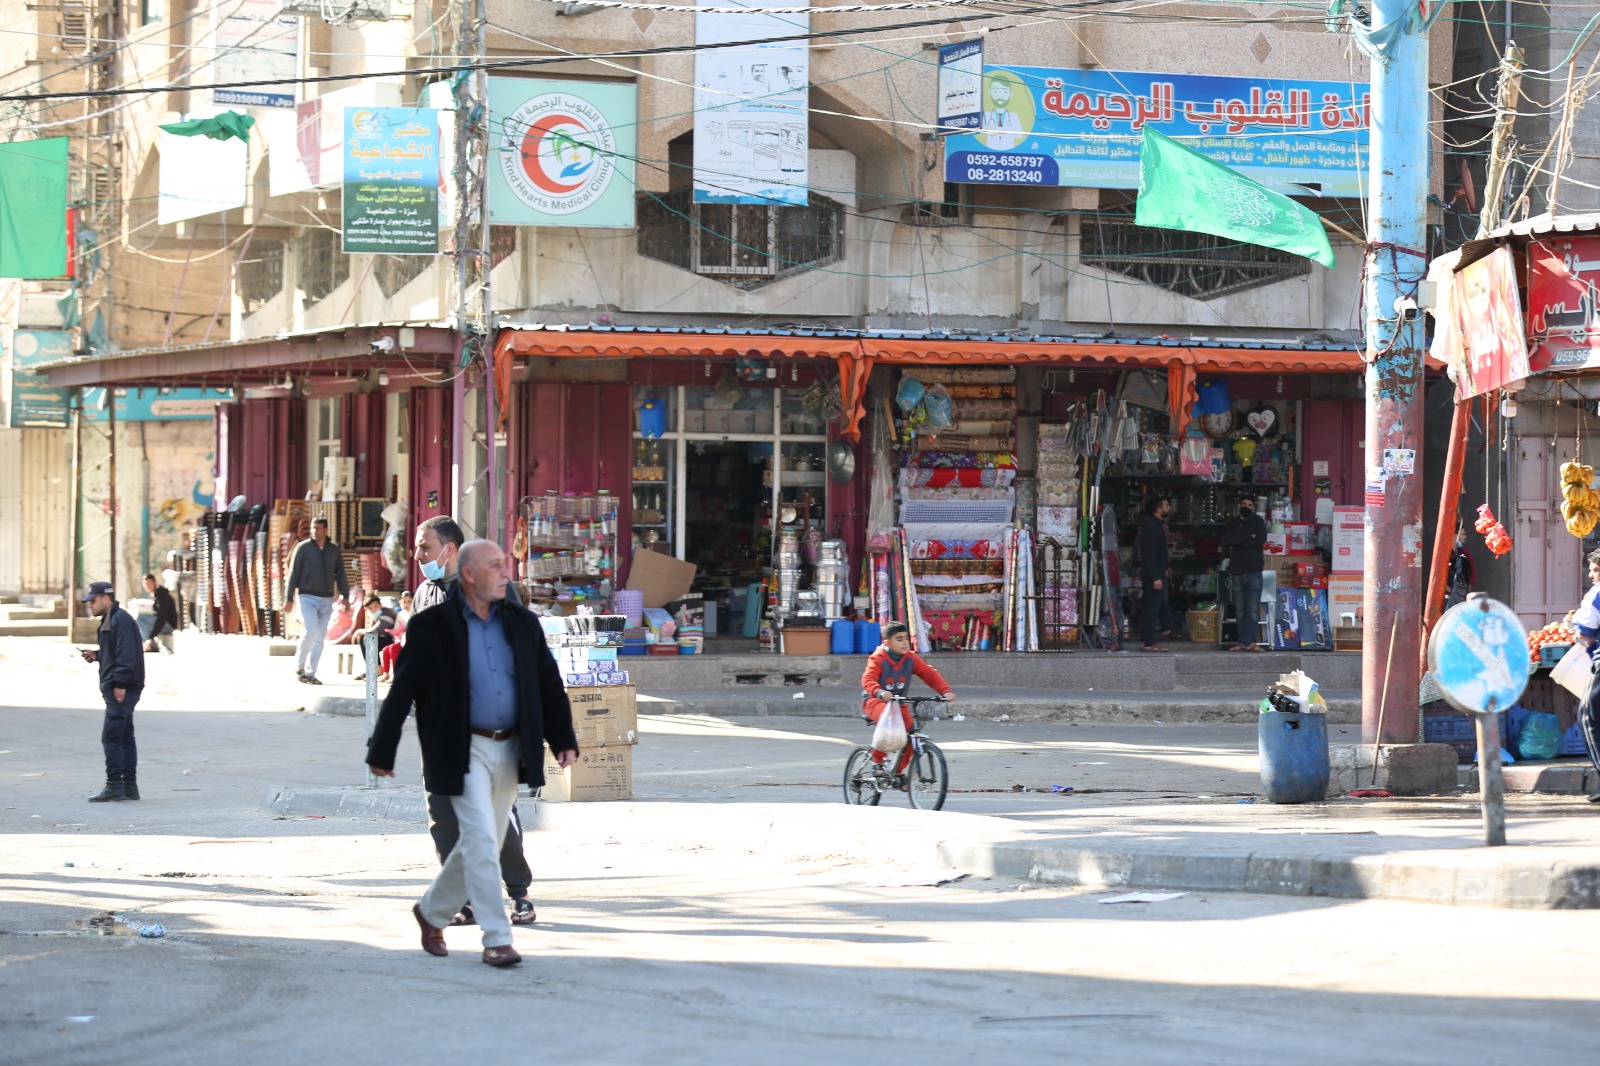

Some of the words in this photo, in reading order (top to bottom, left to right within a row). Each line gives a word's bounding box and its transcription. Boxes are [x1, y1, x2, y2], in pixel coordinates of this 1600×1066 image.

[526, 96, 562, 115] الرحيمة
[564, 99, 600, 124] القلوب
[1043, 78, 1174, 131] الرحيمة
[1185, 88, 1310, 134] القلوب
[393, 122, 430, 138] مختبر
[598, 124, 613, 150] عيادة
[1086, 145, 1108, 156] لكافة
[1234, 137, 1254, 150] عيادة
[1262, 140, 1290, 153] والعقم
[1291, 140, 1315, 152] الحمل
[1316, 141, 1346, 155] ومتابعة
[1347, 142, 1369, 154] لنساء
[349, 140, 432, 163] الشجاعية
[1054, 144, 1085, 158] التحاليل
[1109, 146, 1133, 159] مختبر
[1231, 151, 1254, 163] تغذية
[967, 153, 1044, 168] 0592-658797
[1289, 153, 1311, 167] طهور
[1317, 154, 1345, 168] وحنجرة
[967, 167, 1042, 183] 08-2813240
[1064, 169, 1083, 178] فقط
[503, 156, 520, 184] Kind
[515, 181, 549, 209] Hearts
[550, 189, 593, 211] Medical
[589, 161, 612, 193] Clinic
[398, 196, 410, 204] من
